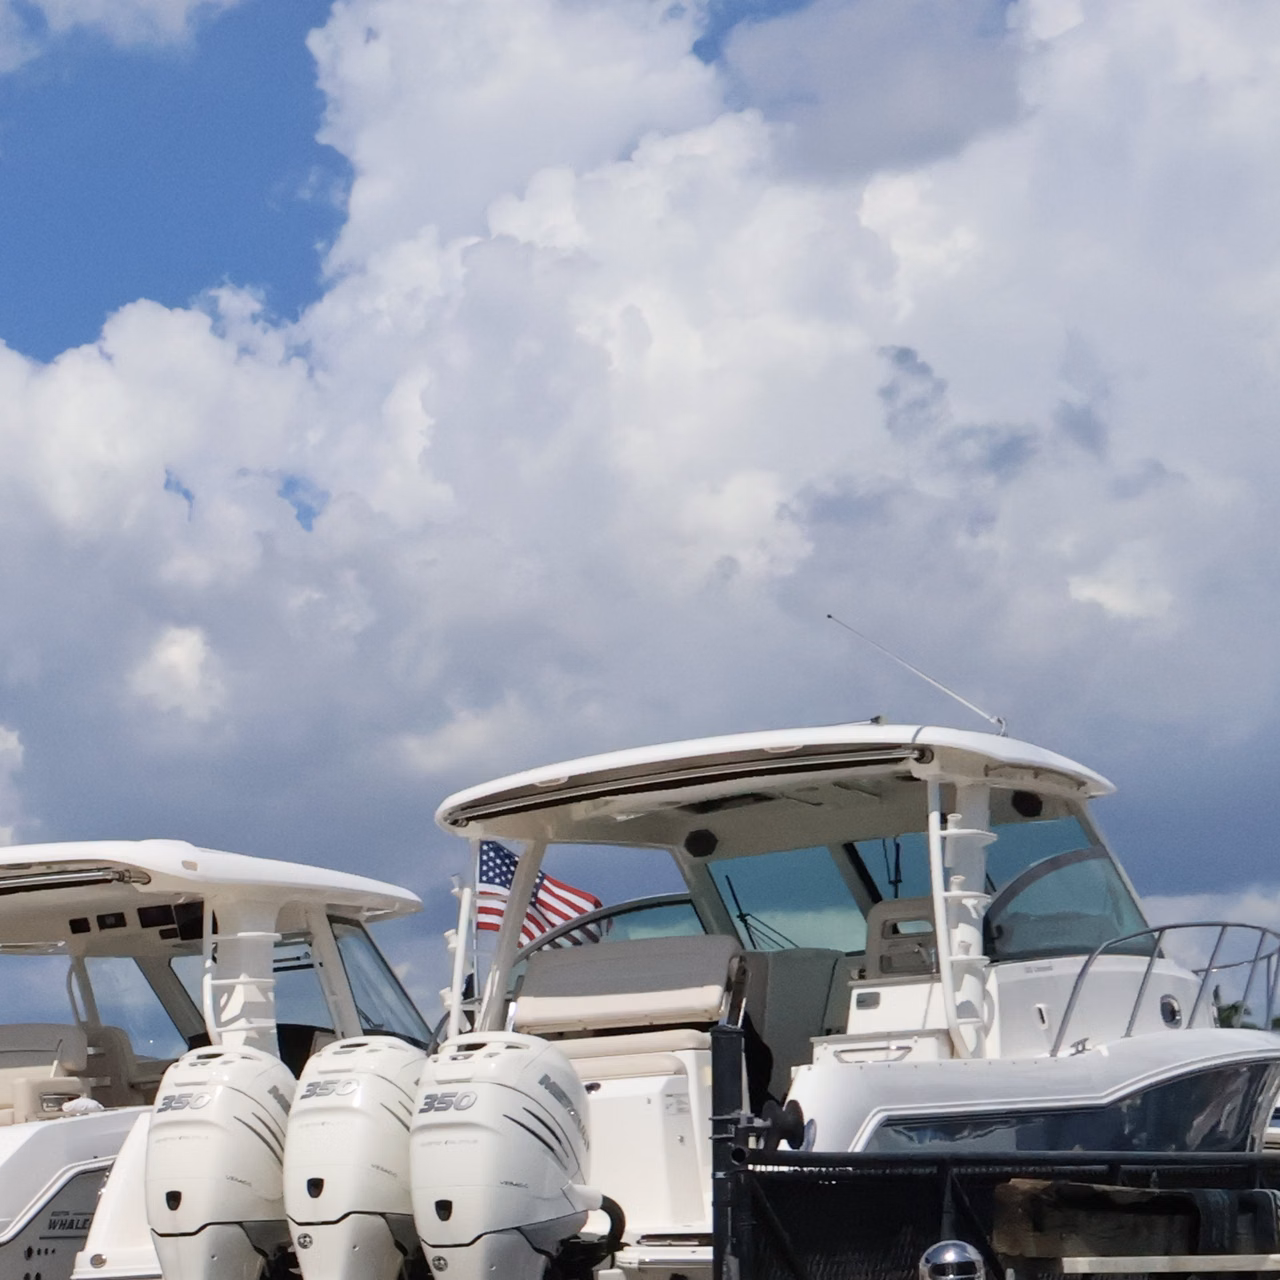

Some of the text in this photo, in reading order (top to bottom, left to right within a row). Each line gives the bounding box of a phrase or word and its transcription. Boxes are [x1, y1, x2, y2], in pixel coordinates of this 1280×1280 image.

[299, 1078, 360, 1100] 350
[156, 1092, 212, 1114] 350
[418, 1091, 478, 1114] 350
[48, 1218, 90, 1230] WHALE
